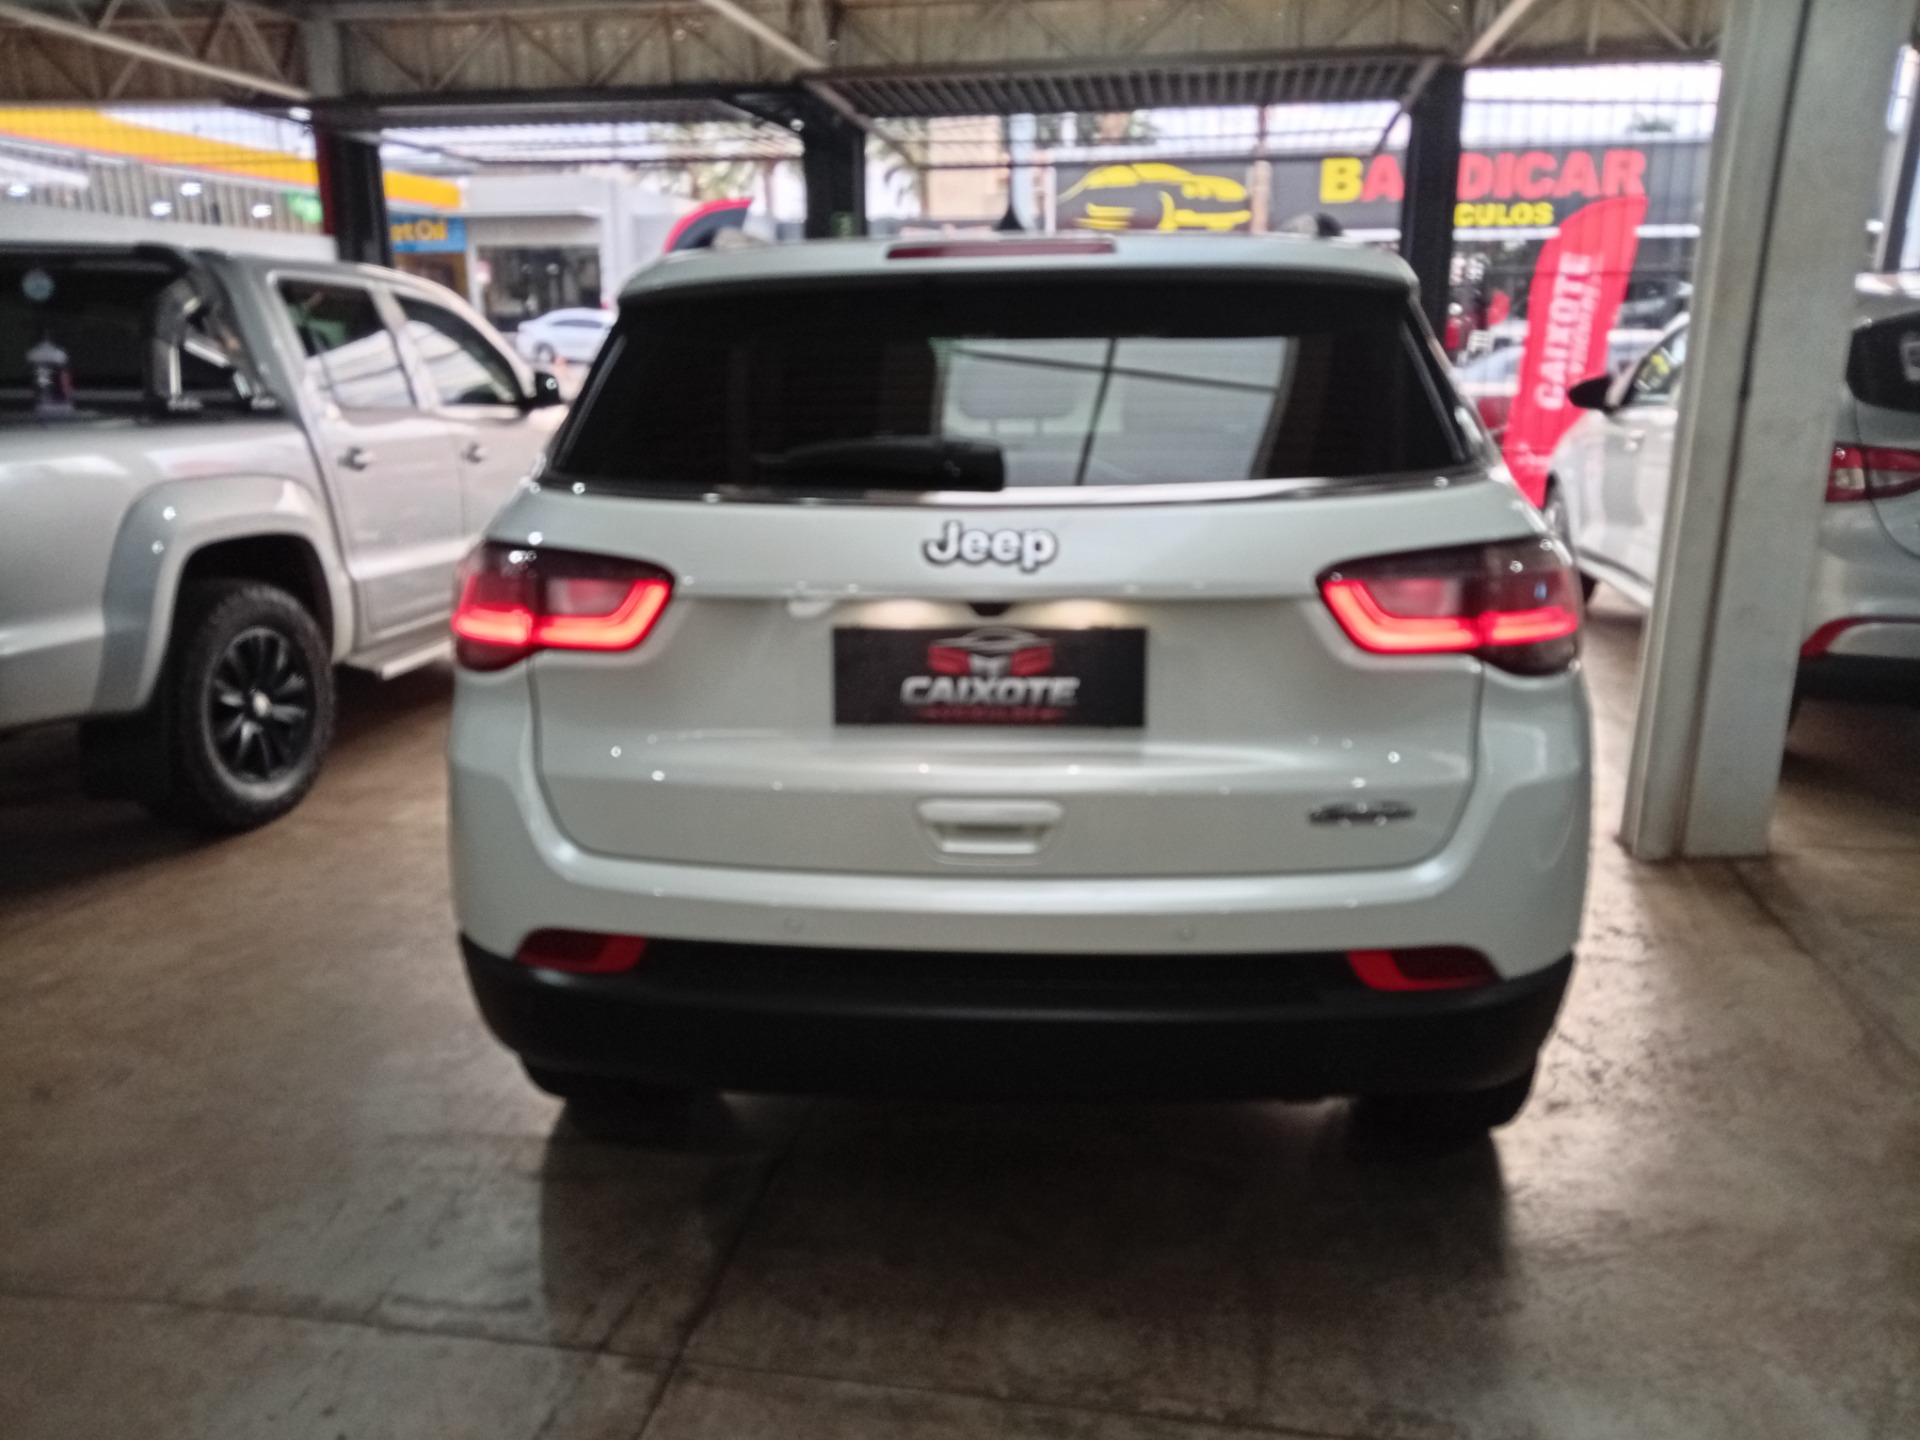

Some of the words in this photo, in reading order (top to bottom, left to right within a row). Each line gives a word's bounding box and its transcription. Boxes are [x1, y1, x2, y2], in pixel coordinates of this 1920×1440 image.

[1320, 149, 1647, 204] BADICAR
[1453, 202, 1554, 227] CULOS
[1535, 252, 1592, 410] CAIXOTE
[922, 520, 1057, 572] Jeep
[901, 675, 1081, 706] CAIXOTE
